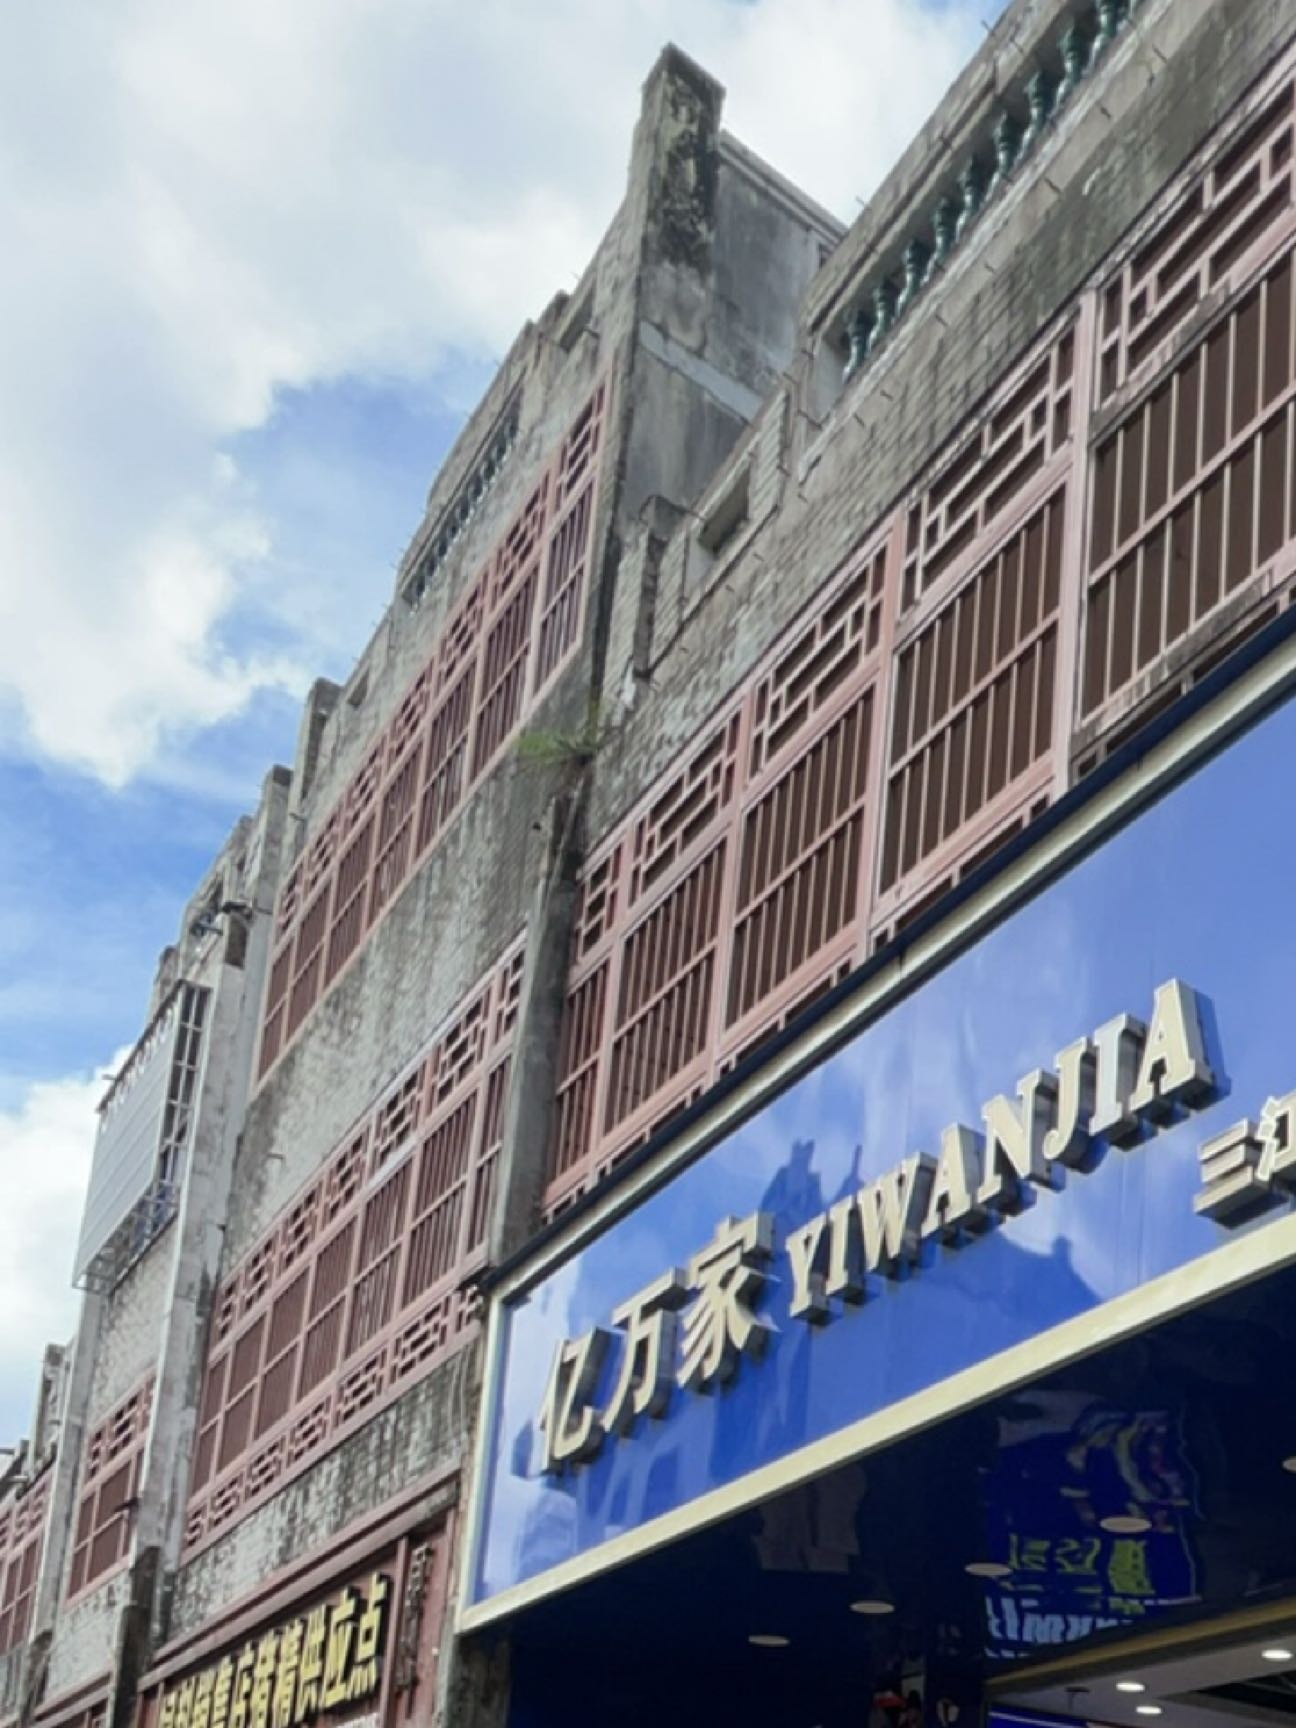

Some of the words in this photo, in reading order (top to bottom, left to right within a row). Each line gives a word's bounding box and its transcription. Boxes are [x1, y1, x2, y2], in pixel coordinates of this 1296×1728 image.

[786, 979, 1210, 1316] YIWANJIA
[539, 1213, 773, 1471] 亿万家
